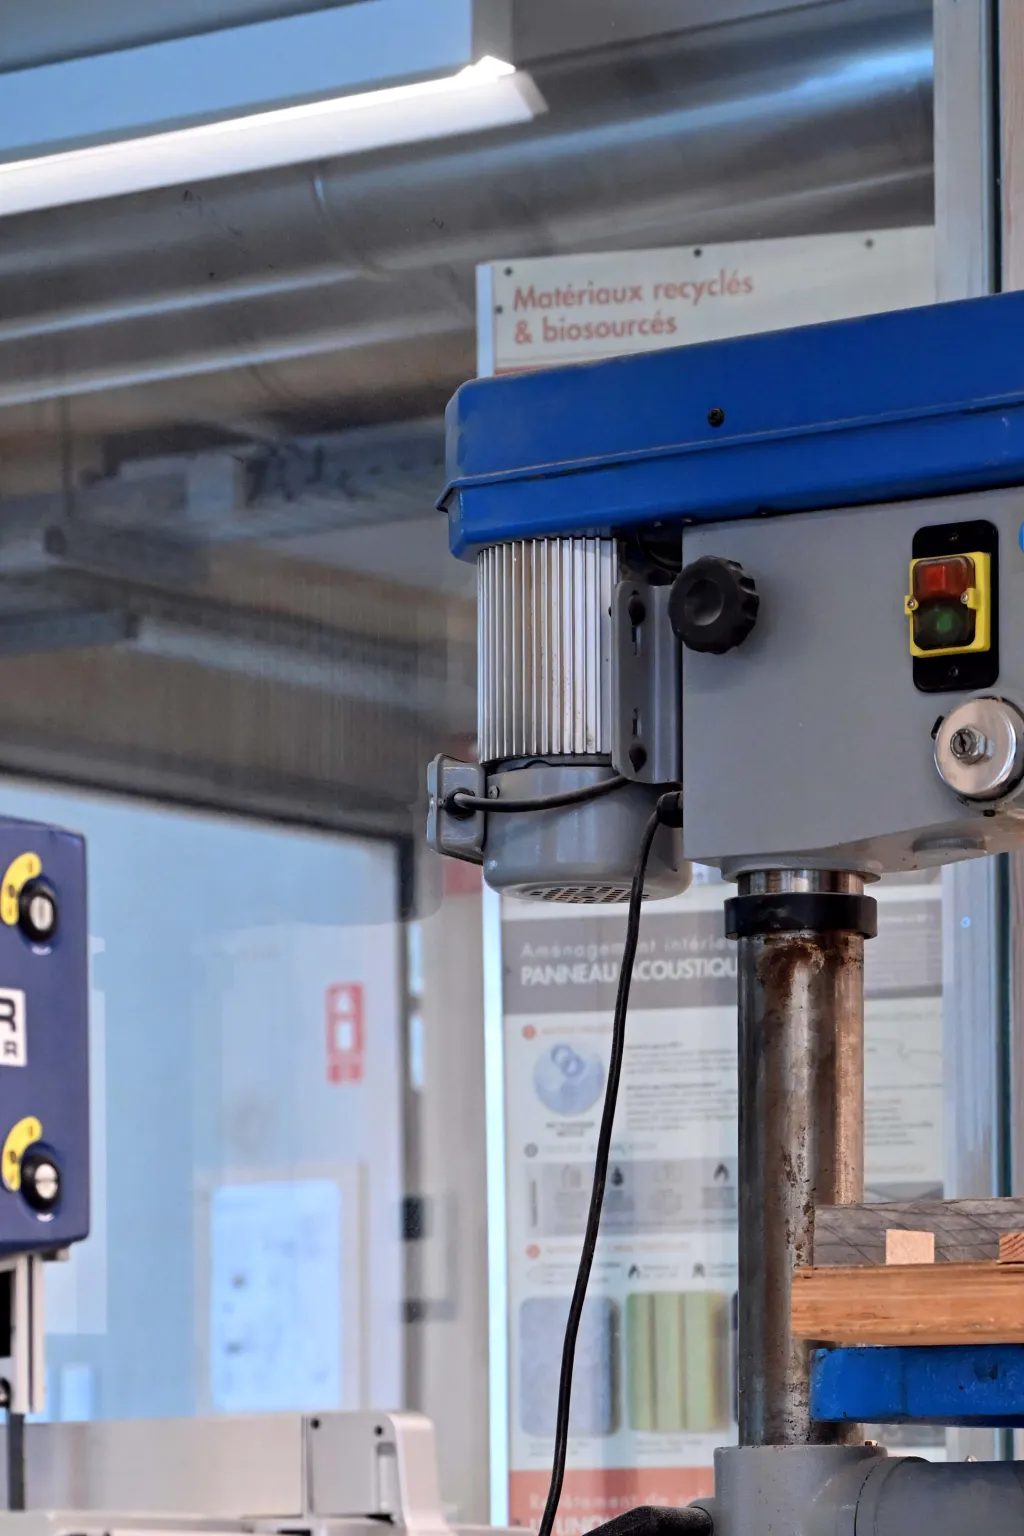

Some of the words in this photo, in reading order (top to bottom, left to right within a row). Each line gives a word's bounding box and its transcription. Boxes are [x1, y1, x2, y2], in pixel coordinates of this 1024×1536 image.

[513, 280, 642, 311] Matériaux
[653, 269, 754, 305] recyclés
[514, 321, 533, 345] &
[543, 313, 677, 343] biosourcés
[521, 937, 656, 962] Aménagemnt
[665, 934, 738, 953] intérieu
[521, 962, 617, 986] PANNEAU
[631, 957, 738, 981] COUSTIQU
